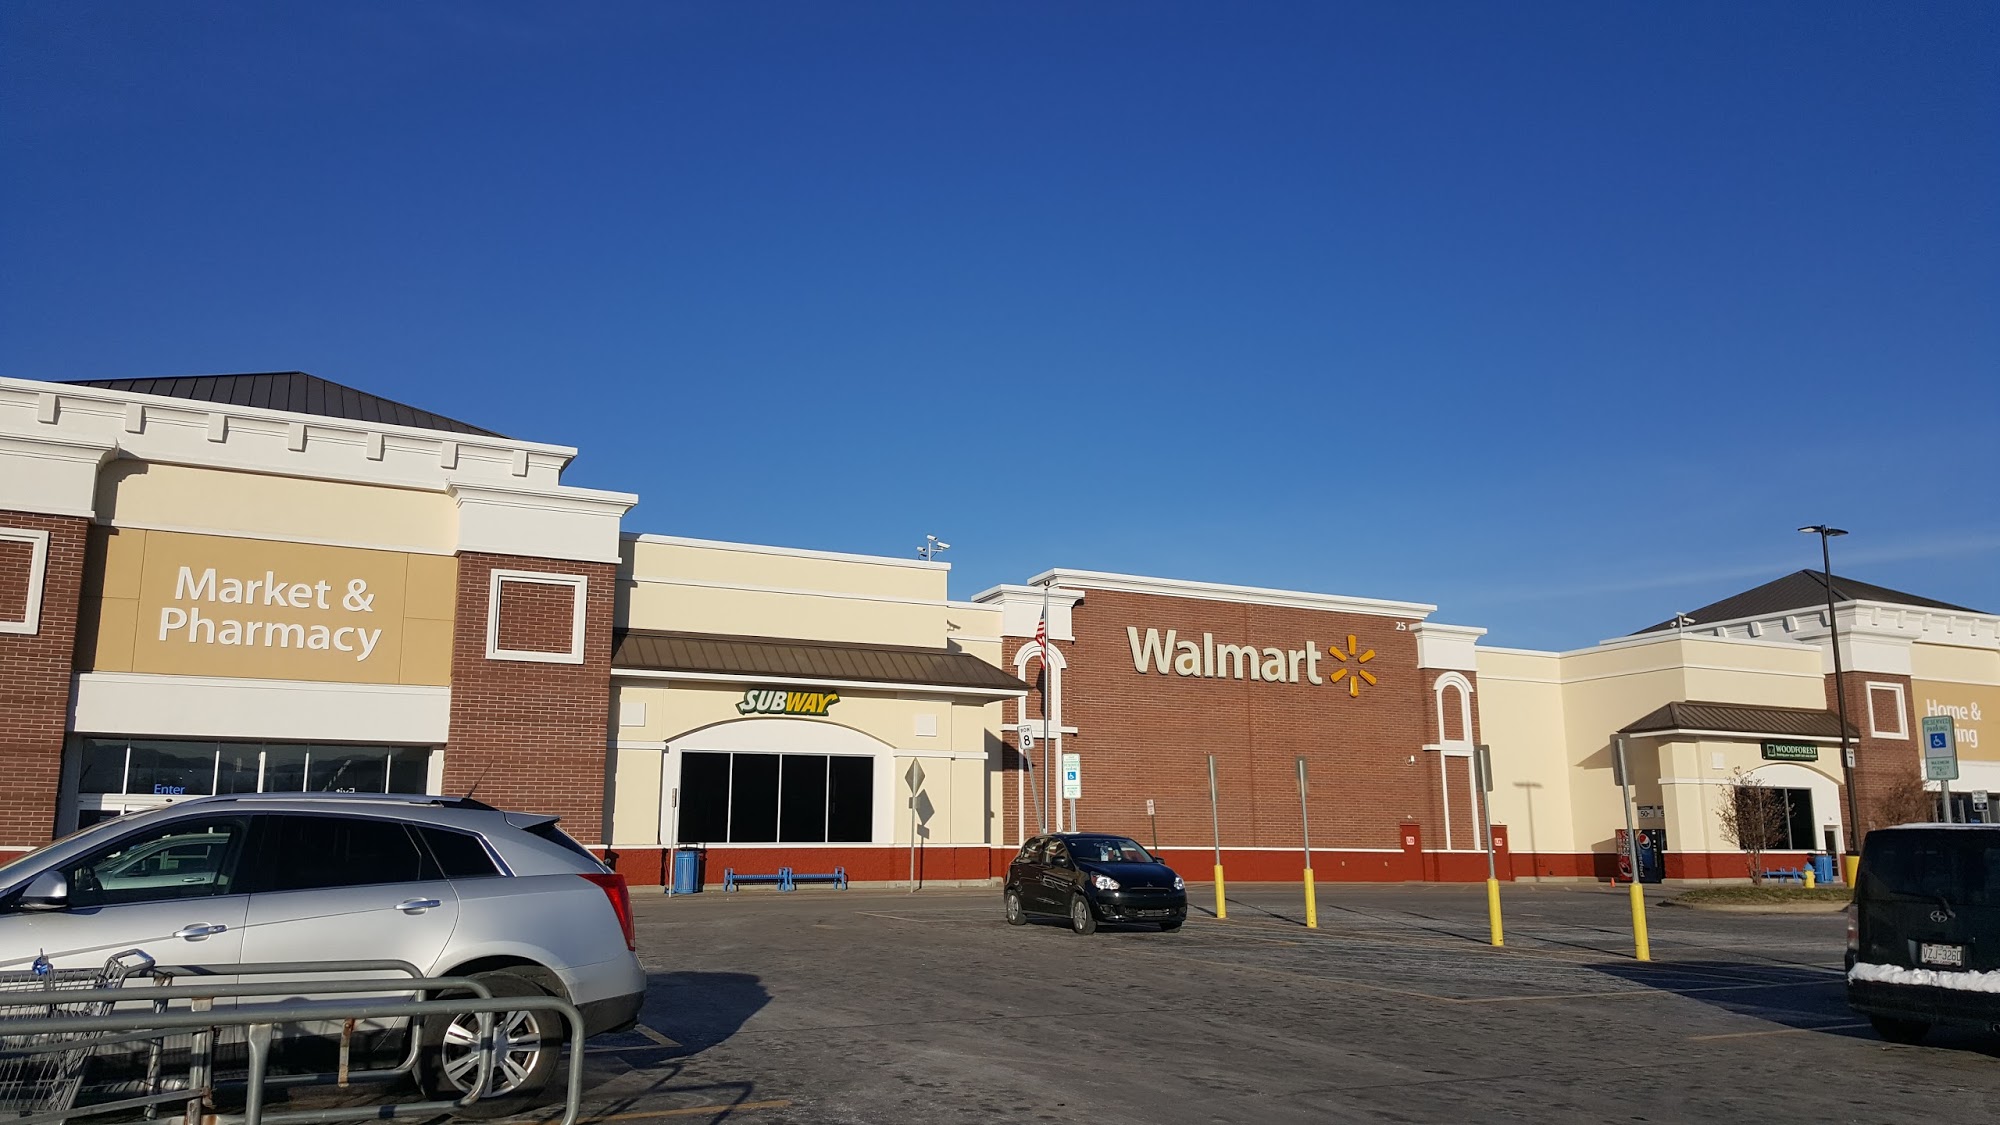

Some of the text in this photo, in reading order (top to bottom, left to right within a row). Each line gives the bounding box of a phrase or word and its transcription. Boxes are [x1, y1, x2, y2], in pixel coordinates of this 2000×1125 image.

[174, 566, 375, 612] Market &
[158, 607, 382, 662] Pharmacy
[1395, 621, 1406, 631] 25
[1126, 626, 1323, 686] Walmart
[738, 689, 839, 713] SUBWAY
[1927, 699, 1981, 720] Home &
[1024, 735, 1030, 746] 8
[1955, 724, 1978, 748] ing
[1775, 744, 1817, 755] WOODFOREST
[1848, 755, 1854, 766] 7
[153, 783, 186, 795] Enter
